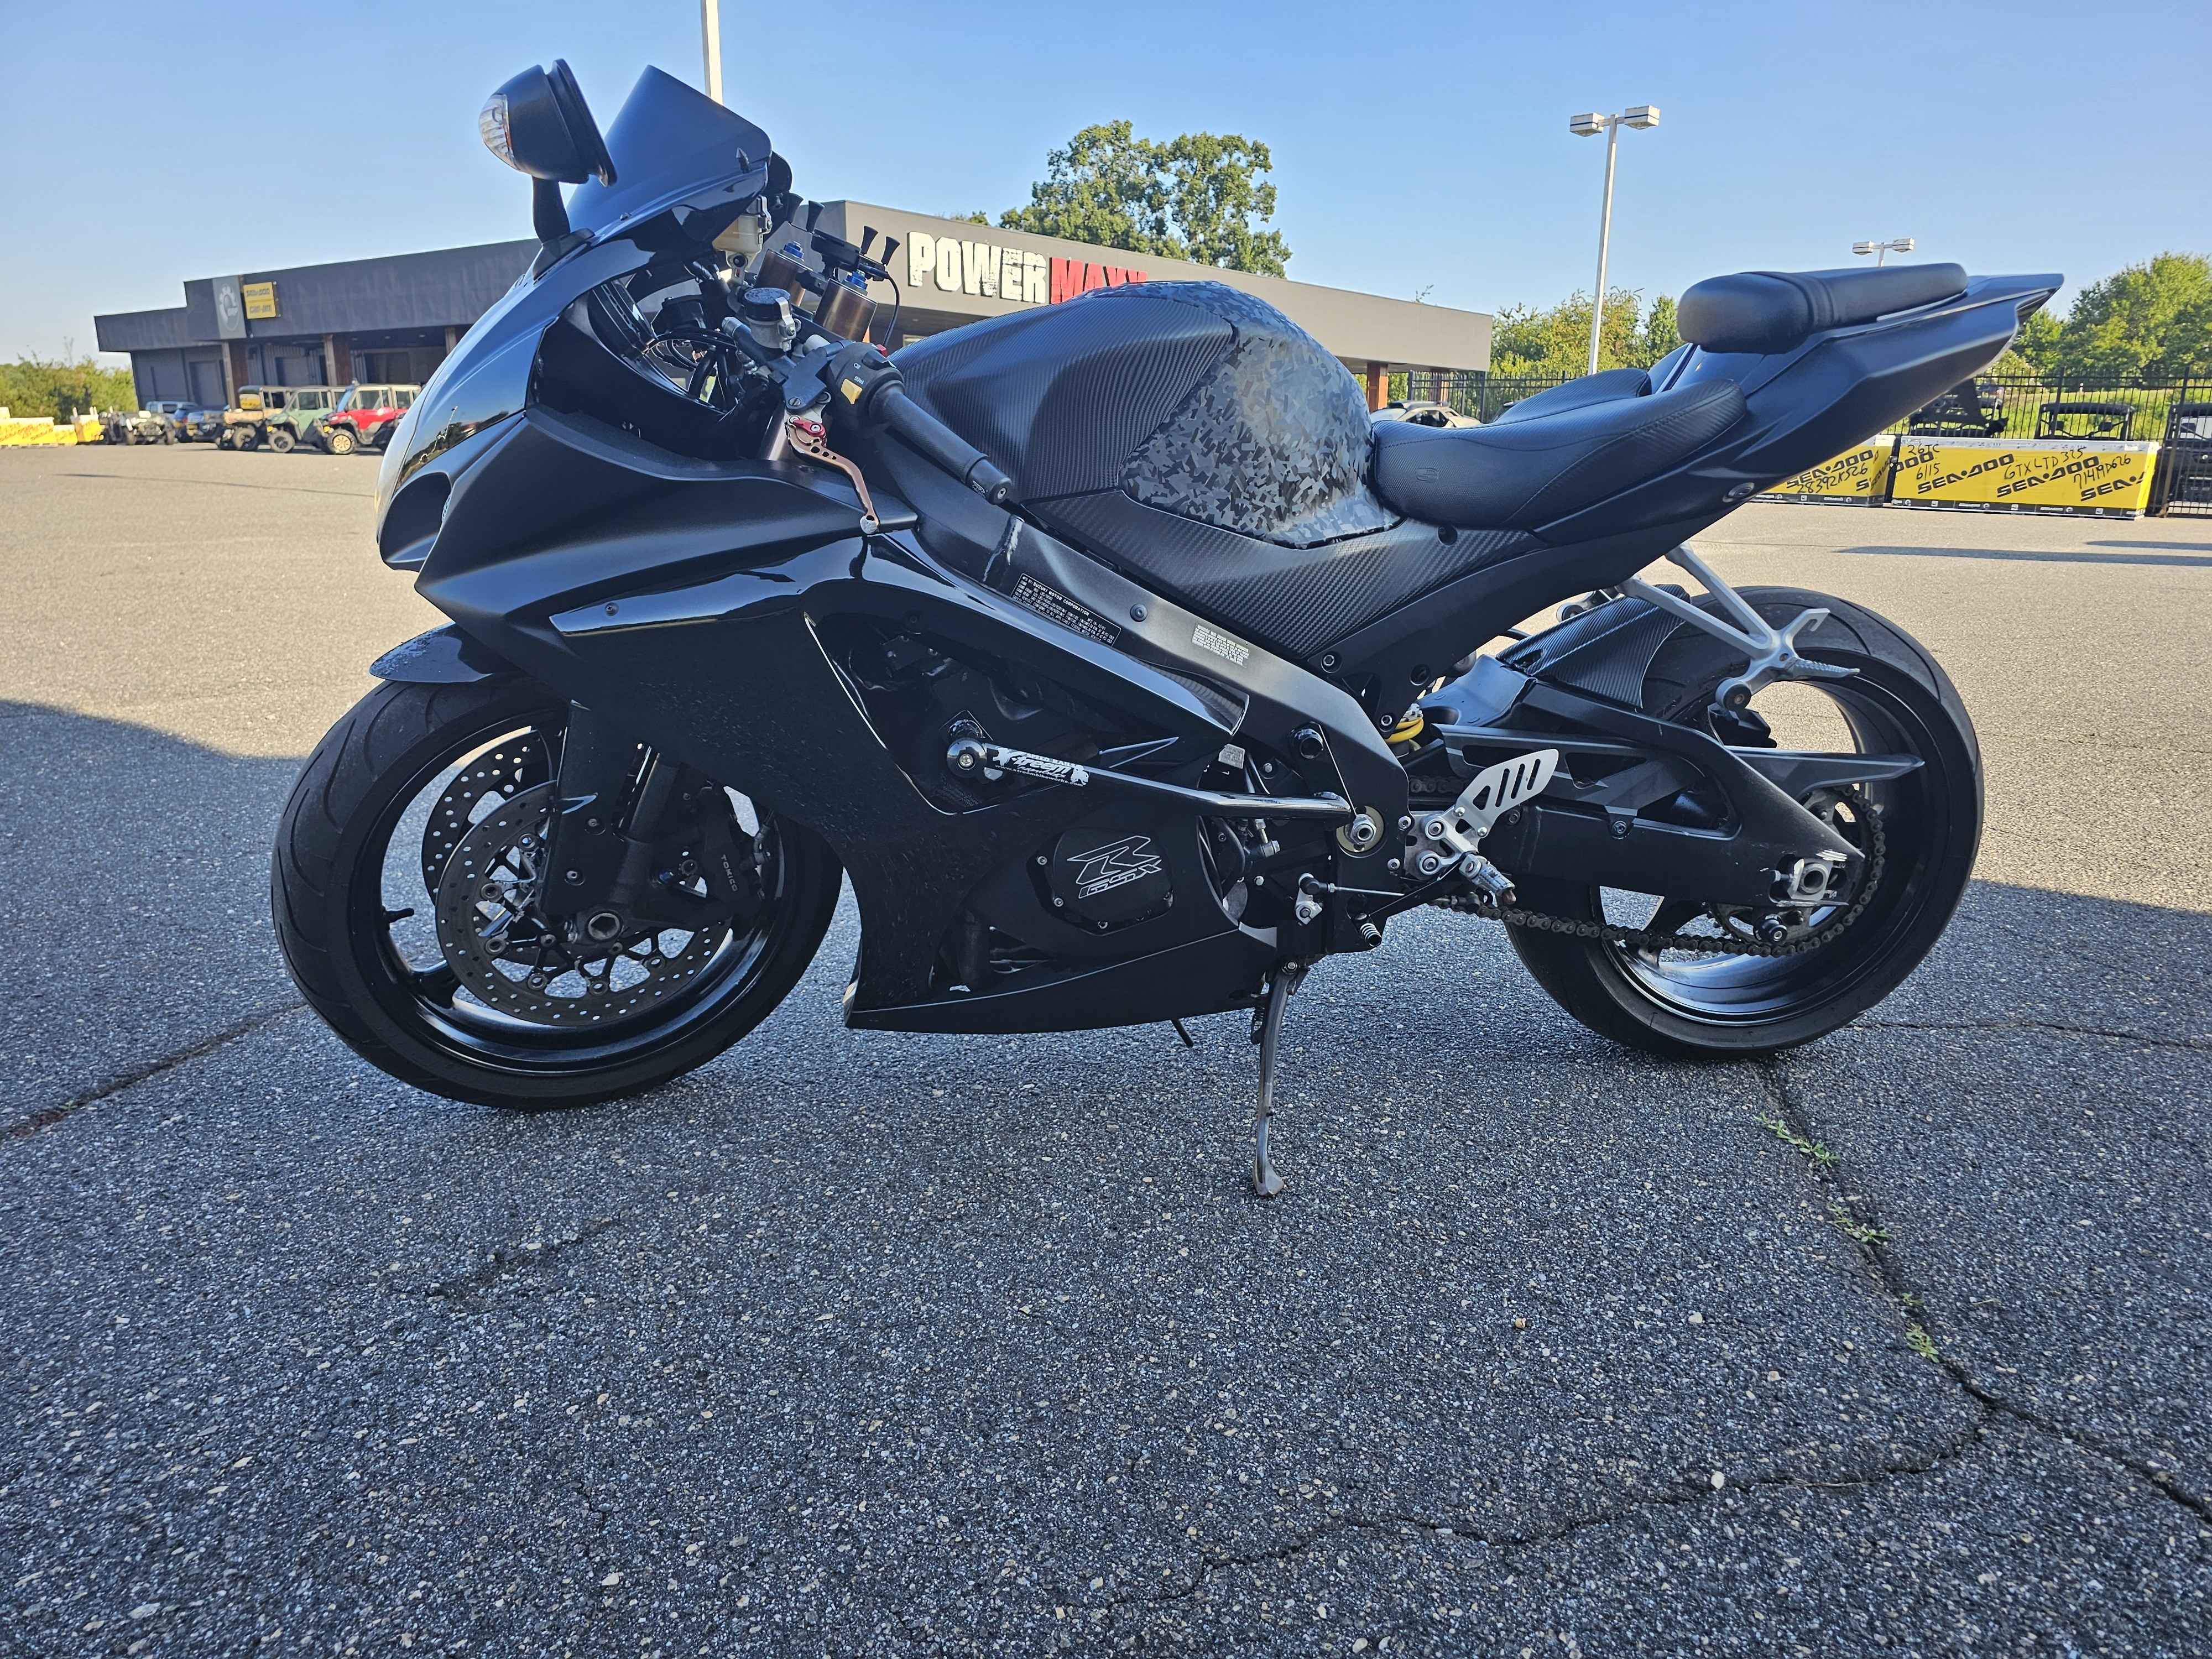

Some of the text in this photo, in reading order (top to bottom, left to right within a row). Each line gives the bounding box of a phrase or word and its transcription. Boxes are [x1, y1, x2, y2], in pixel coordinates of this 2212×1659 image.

[1032, 582, 1047, 592] SUZUKI
[1048, 591, 1062, 600] MOTOR
[1062, 599, 1089, 615] CORPORATION
[1026, 753, 1076, 768] SPEED RAILS
[721, 854, 738, 891] TOKICO
